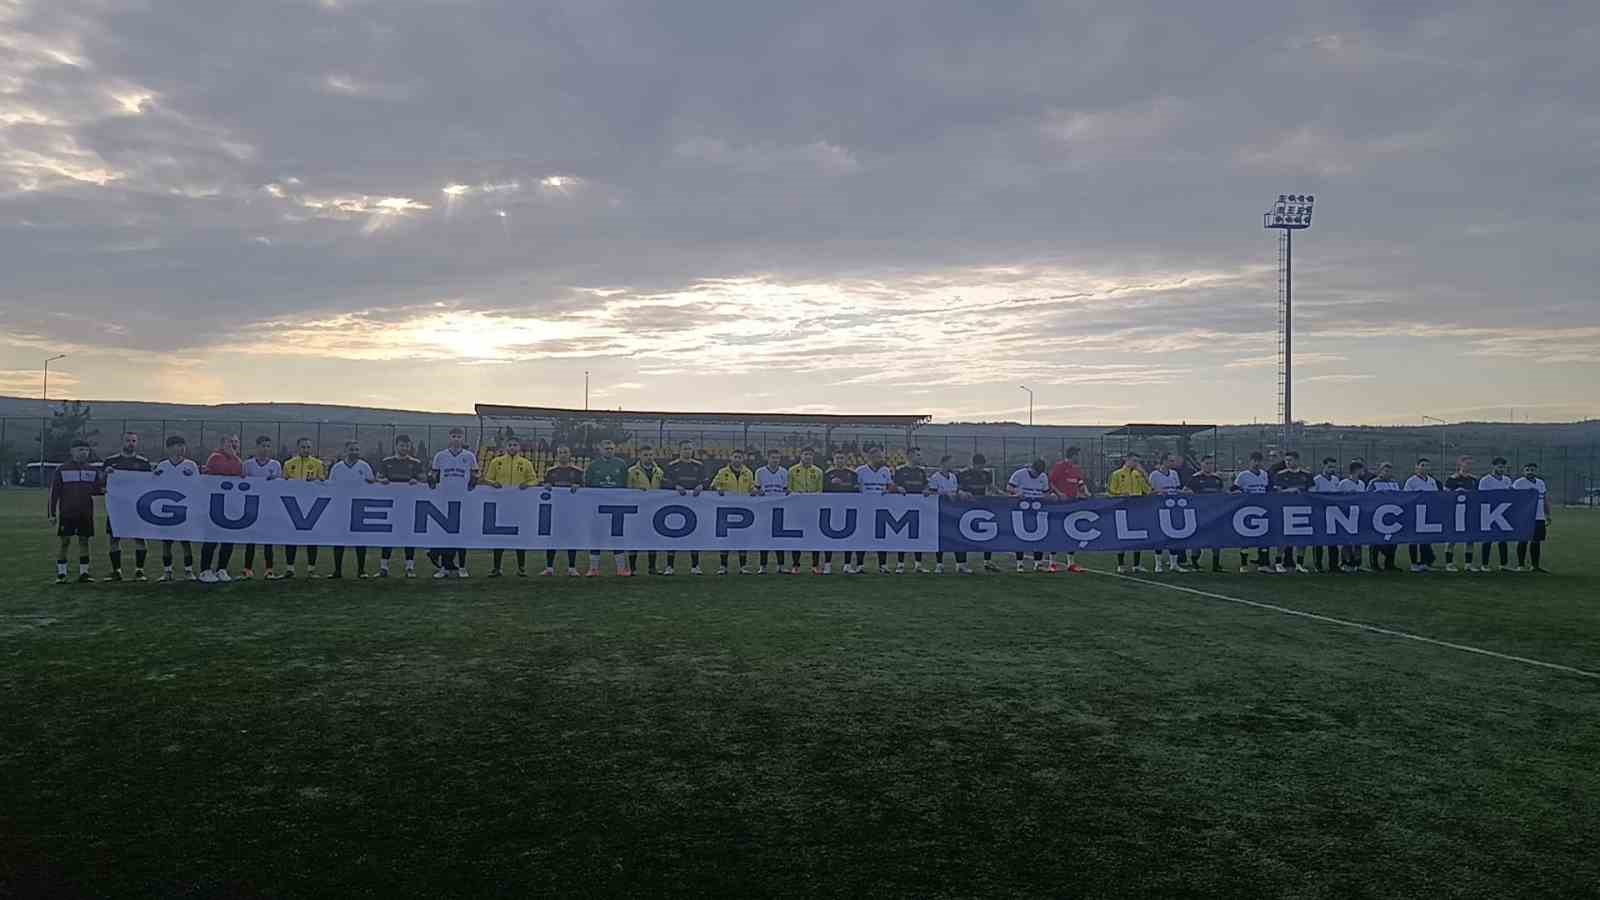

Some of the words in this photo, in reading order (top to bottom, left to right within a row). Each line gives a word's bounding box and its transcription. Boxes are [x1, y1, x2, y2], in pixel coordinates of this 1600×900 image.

[136, 482, 553, 536] GÜVENLİ
[598, 503, 920, 540] TOPLUM
[959, 498, 1198, 548] GÜÇLÜ
[1232, 495, 1514, 541] GENÇLİK
